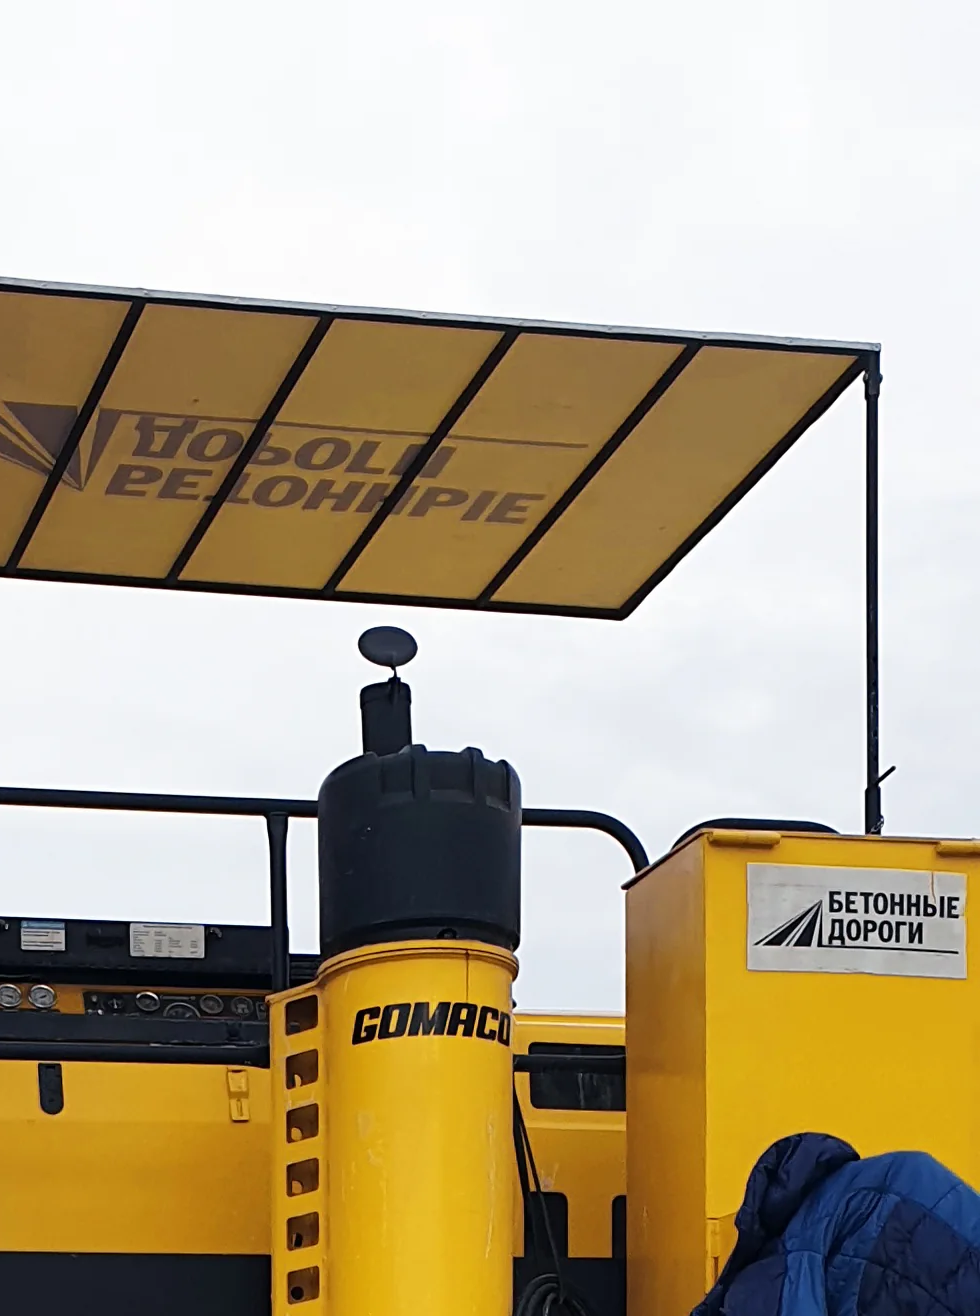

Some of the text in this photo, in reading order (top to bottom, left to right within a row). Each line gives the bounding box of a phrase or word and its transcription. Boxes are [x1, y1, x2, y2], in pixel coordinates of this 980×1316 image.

[828, 891, 960, 919] БЕТОННЫЕ
[828, 918, 924, 945] ДОРОГИ
[352, 1002, 511, 1047] GOMACO
